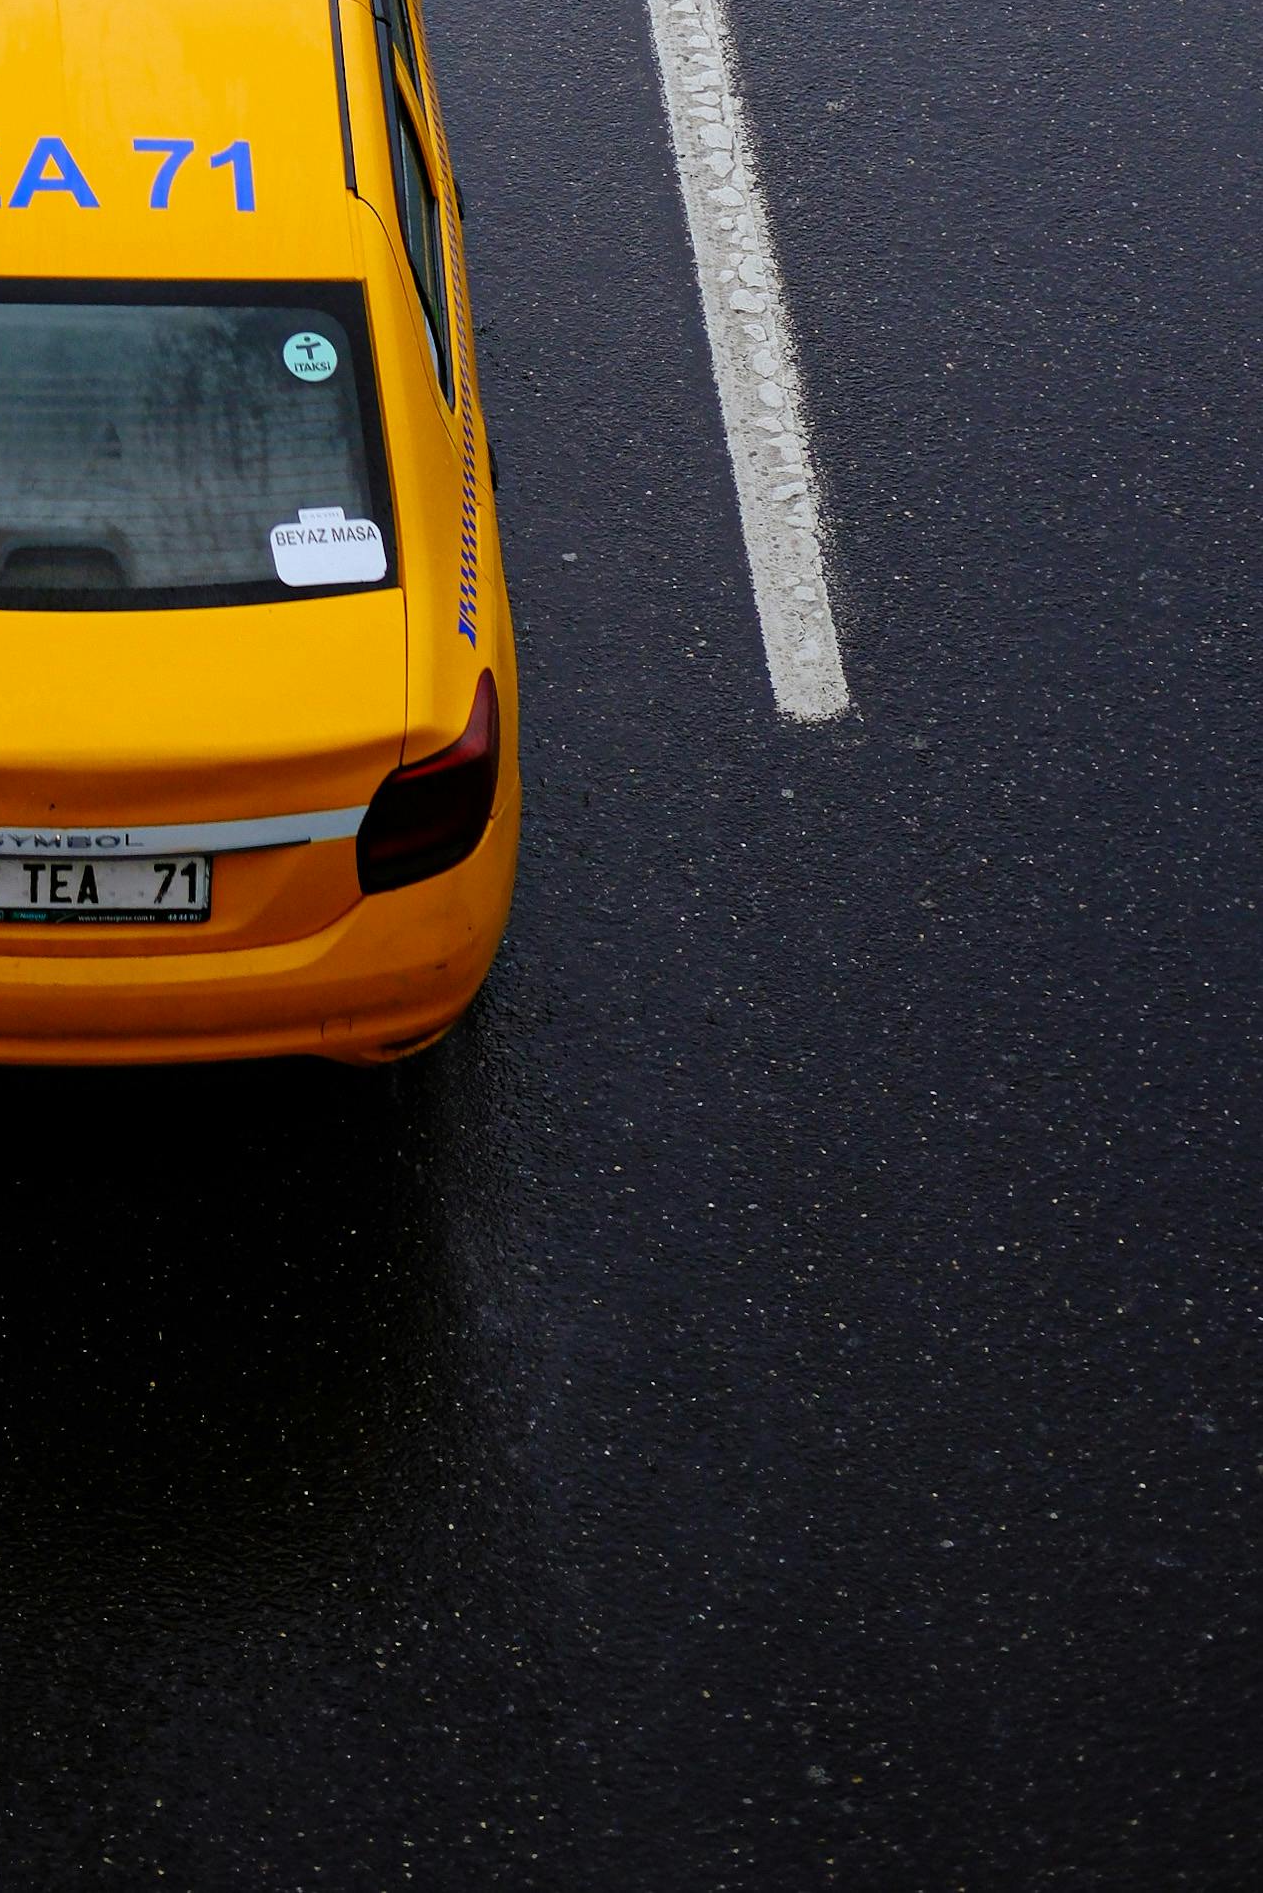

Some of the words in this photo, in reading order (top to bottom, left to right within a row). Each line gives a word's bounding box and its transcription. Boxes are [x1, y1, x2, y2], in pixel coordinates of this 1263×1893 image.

[132, 138, 256, 212] 71
[275, 528, 328, 547] BEYAZ
[331, 526, 378, 543] MASA
[23, 863, 99, 904] TEA
[153, 861, 198, 904] 71
